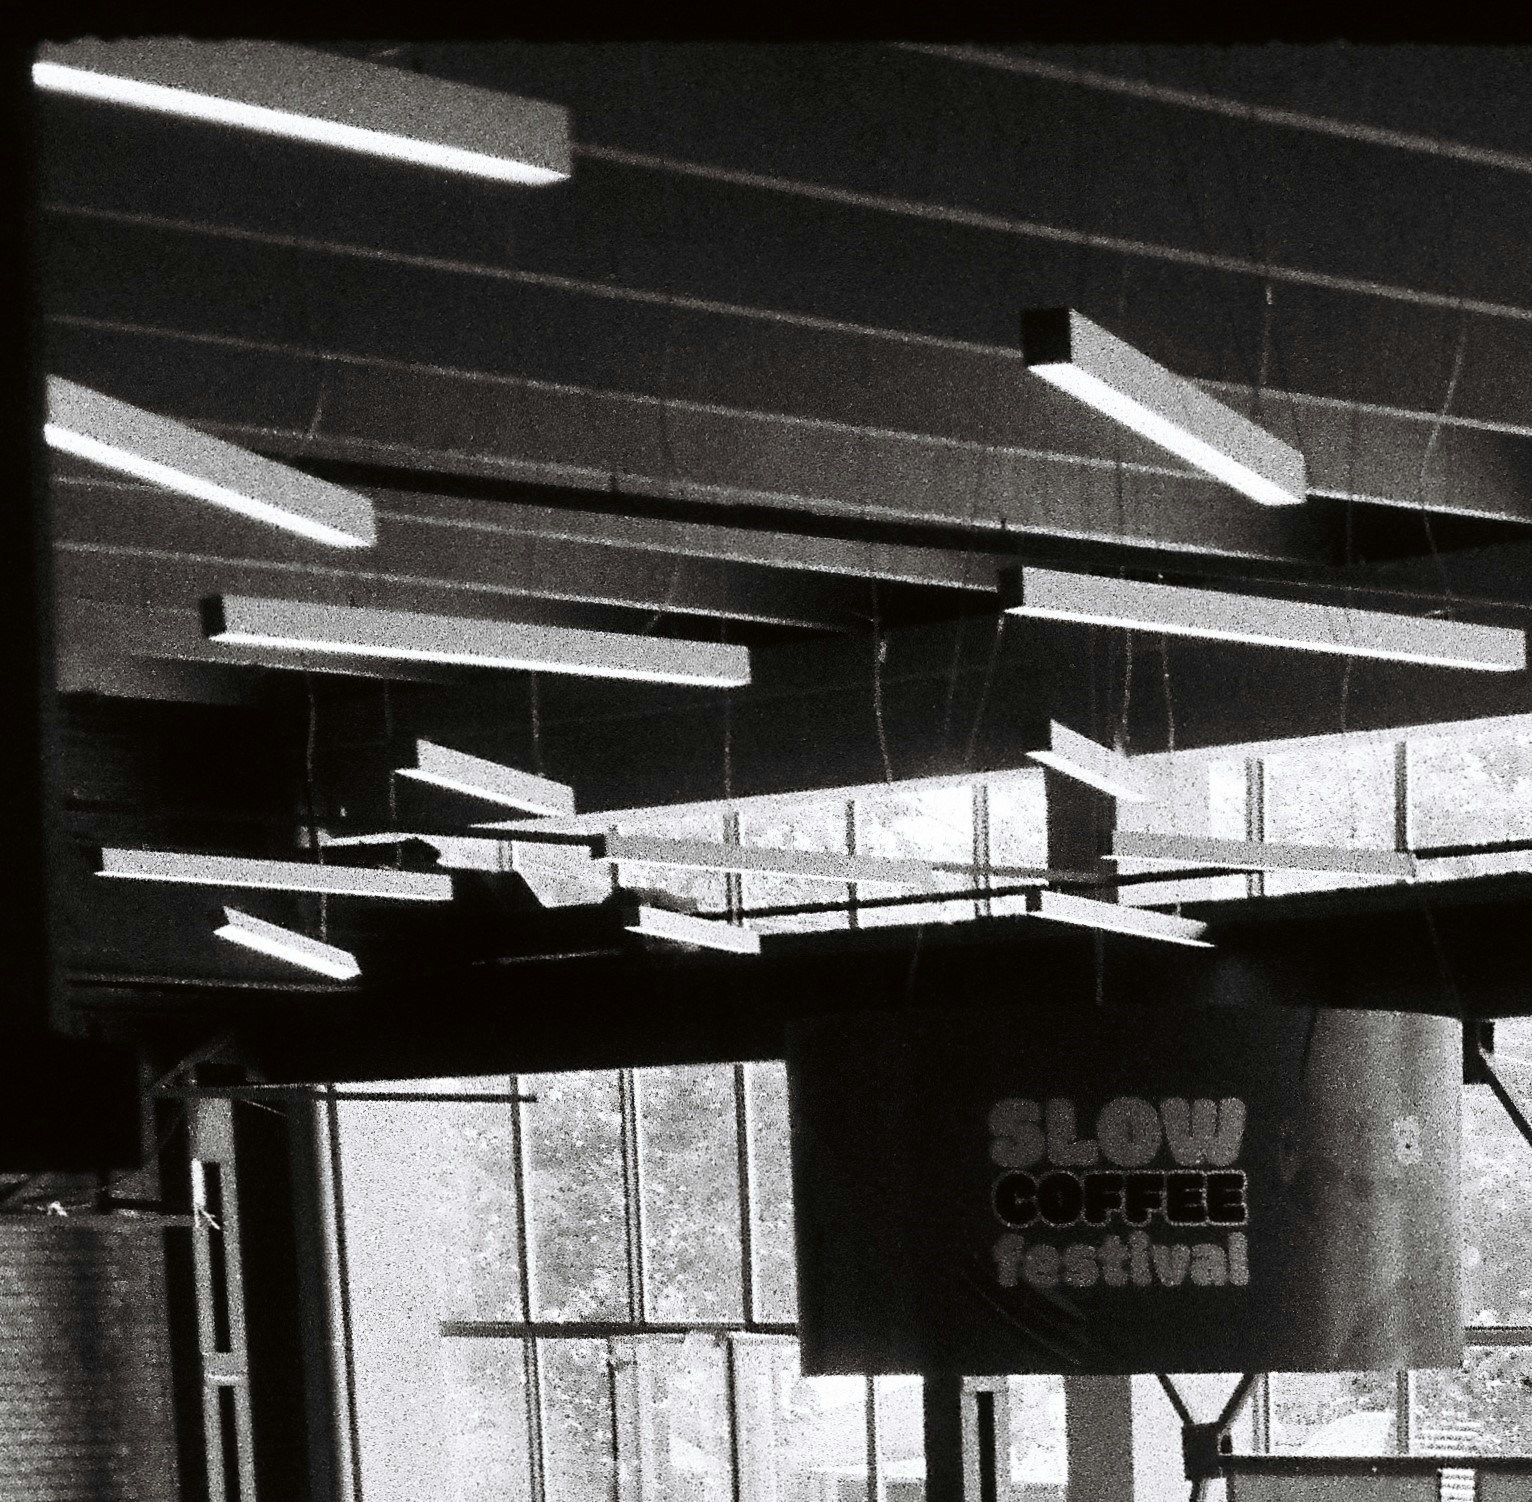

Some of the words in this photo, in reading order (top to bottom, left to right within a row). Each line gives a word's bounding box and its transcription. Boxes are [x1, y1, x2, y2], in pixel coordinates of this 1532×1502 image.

[987, 1096, 1248, 1168] SLOW
[990, 1169, 1250, 1229] COFFEE
[992, 1230, 1252, 1288] festival
